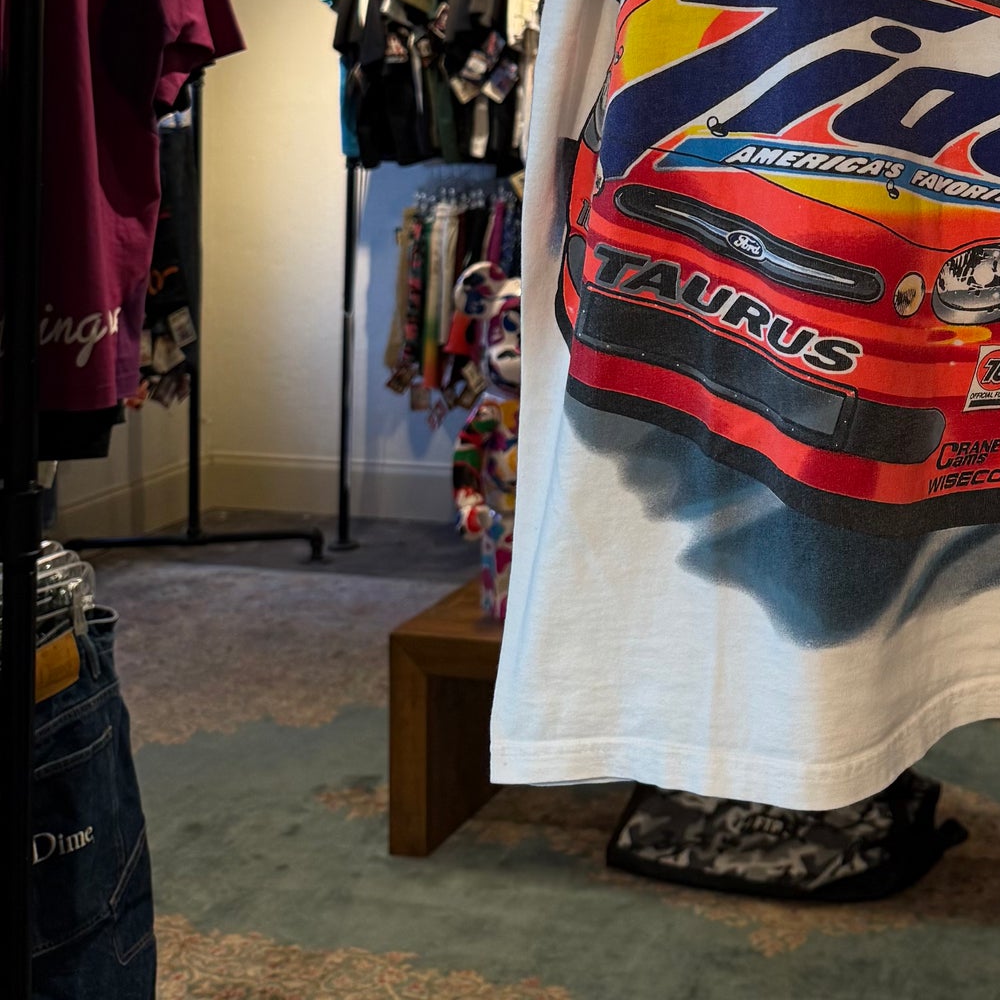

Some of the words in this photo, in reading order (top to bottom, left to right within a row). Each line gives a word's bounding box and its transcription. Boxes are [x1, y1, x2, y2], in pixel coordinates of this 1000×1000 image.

[724, 145, 904, 178] AMERICA'S
[733, 233, 761, 255] Ford
[594, 242, 863, 374] TAURUS
[32, 824, 95, 866] Dime
